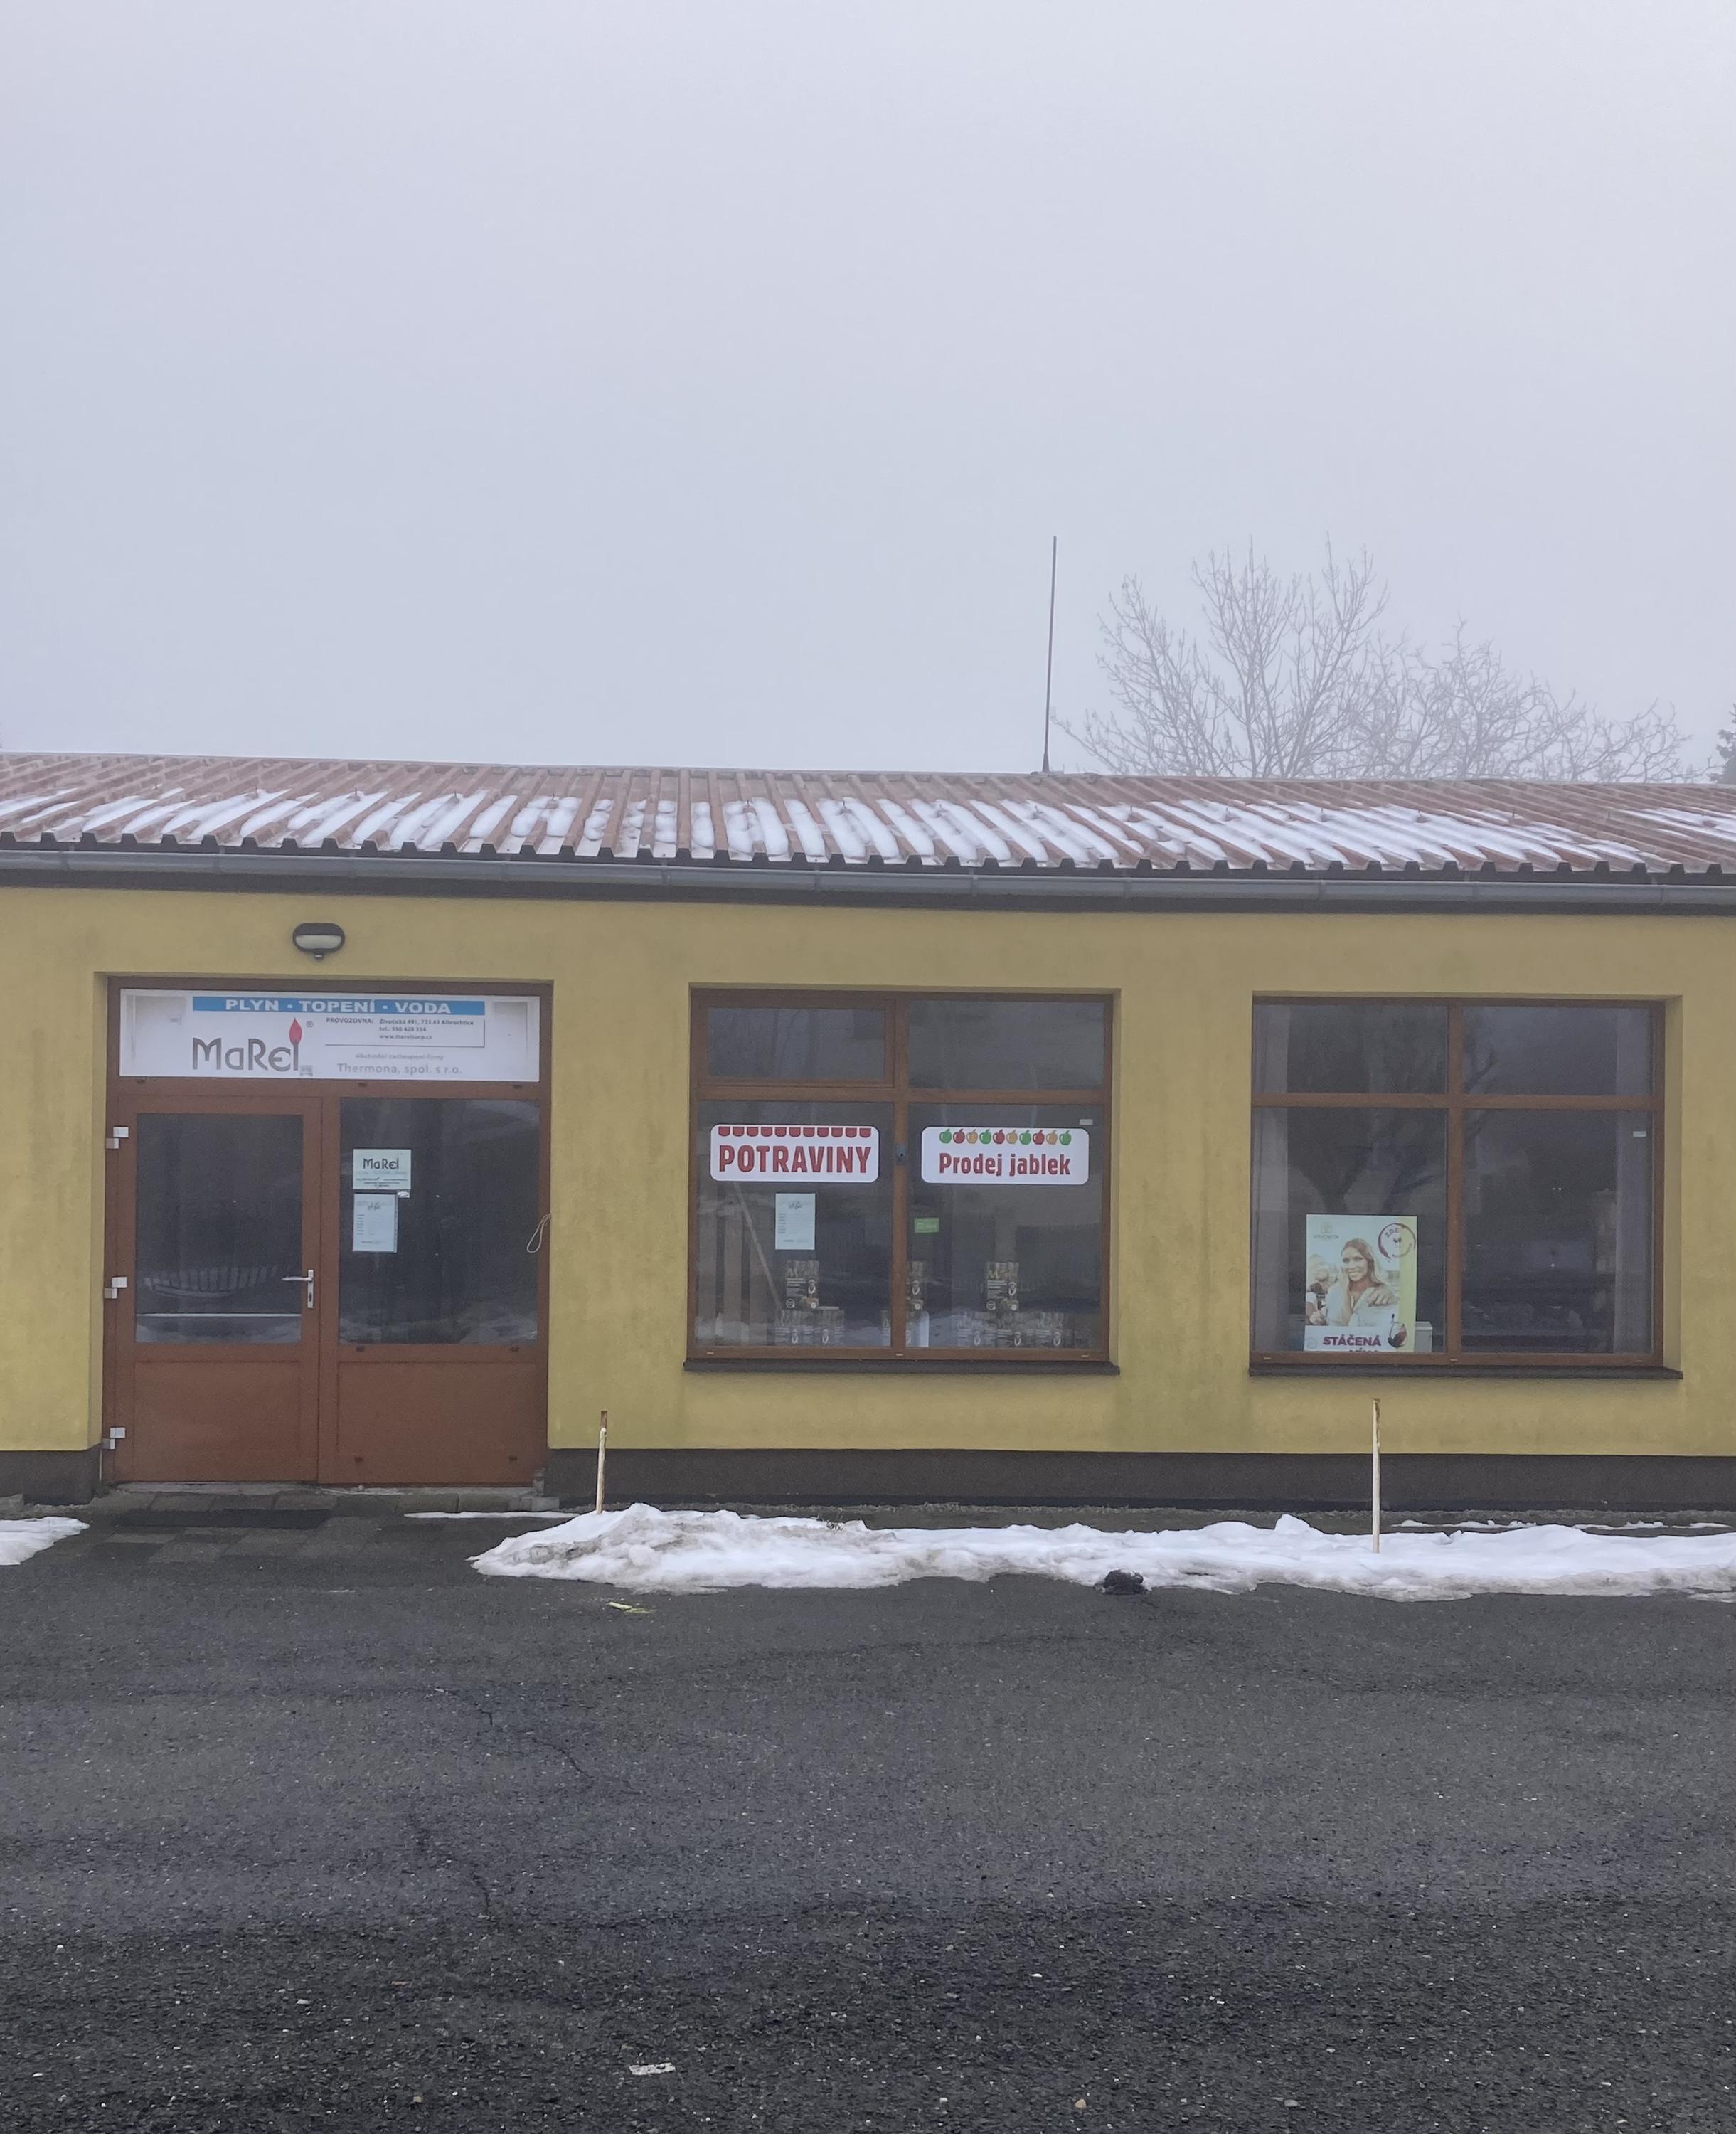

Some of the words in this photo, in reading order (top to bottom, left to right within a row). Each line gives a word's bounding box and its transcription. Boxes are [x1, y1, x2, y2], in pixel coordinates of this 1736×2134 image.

[225, 999, 279, 1011] PLYN
[299, 999, 376, 1013] TOPENÍ
[395, 1002, 451, 1014] VODA
[337, 1063, 400, 1075] Thermona,
[404, 1065, 432, 1076] spol.
[718, 1144, 872, 1174] POTRAVINY
[939, 1152, 1003, 1177] Prodej
[1009, 1153, 1071, 1176] jablek
[1323, 1334, 1382, 1347] STÁČENÁ
